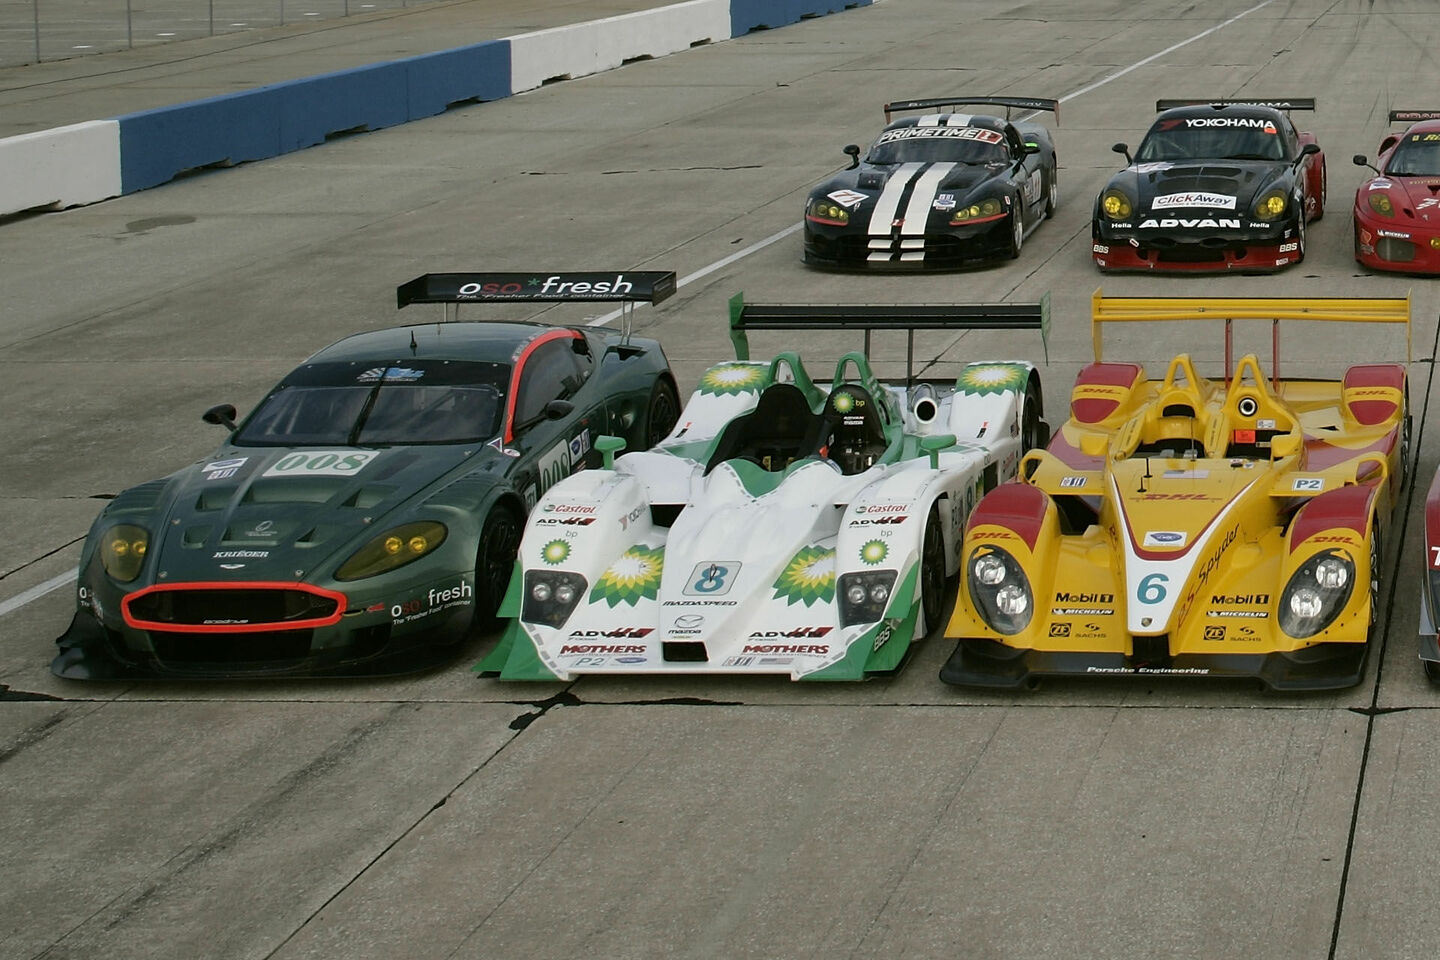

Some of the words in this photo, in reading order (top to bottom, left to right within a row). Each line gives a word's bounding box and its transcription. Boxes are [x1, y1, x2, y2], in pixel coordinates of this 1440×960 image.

[1185, 118, 1276, 129] YOKOHAMA
[880, 126, 977, 143] PRIMETIME
[1157, 194, 1232, 205] ClickAway
[1138, 219, 1241, 228] ADVAN
[1279, 242, 1298, 253] BBS
[459, 282, 522, 295] oso
[541, 275, 633, 294] fresh
[855, 399, 865, 407] bp
[274, 453, 370, 471] 008
[1296, 479, 1321, 489] P2
[1144, 493, 1210, 501] DHL
[555, 504, 597, 514] Castrol
[868, 504, 908, 514] Castrol
[565, 530, 578, 538] bp
[880, 529, 893, 538] bp
[972, 532, 1012, 540] DHL
[1313, 536, 1355, 544] DHL
[1196, 524, 1240, 592] Spyder
[694, 565, 729, 593] 8
[1136, 573, 1169, 605] 6
[391, 599, 421, 618] oso
[428, 581, 472, 606] fresh
[1055, 592, 1098, 603] Mobil
[1211, 595, 1253, 605] Mobil
[873, 626, 892, 652] BBS
[560, 645, 648, 655] MOTHERS
[742, 645, 830, 654] MOTHERS
[575, 657, 605, 666] P2
